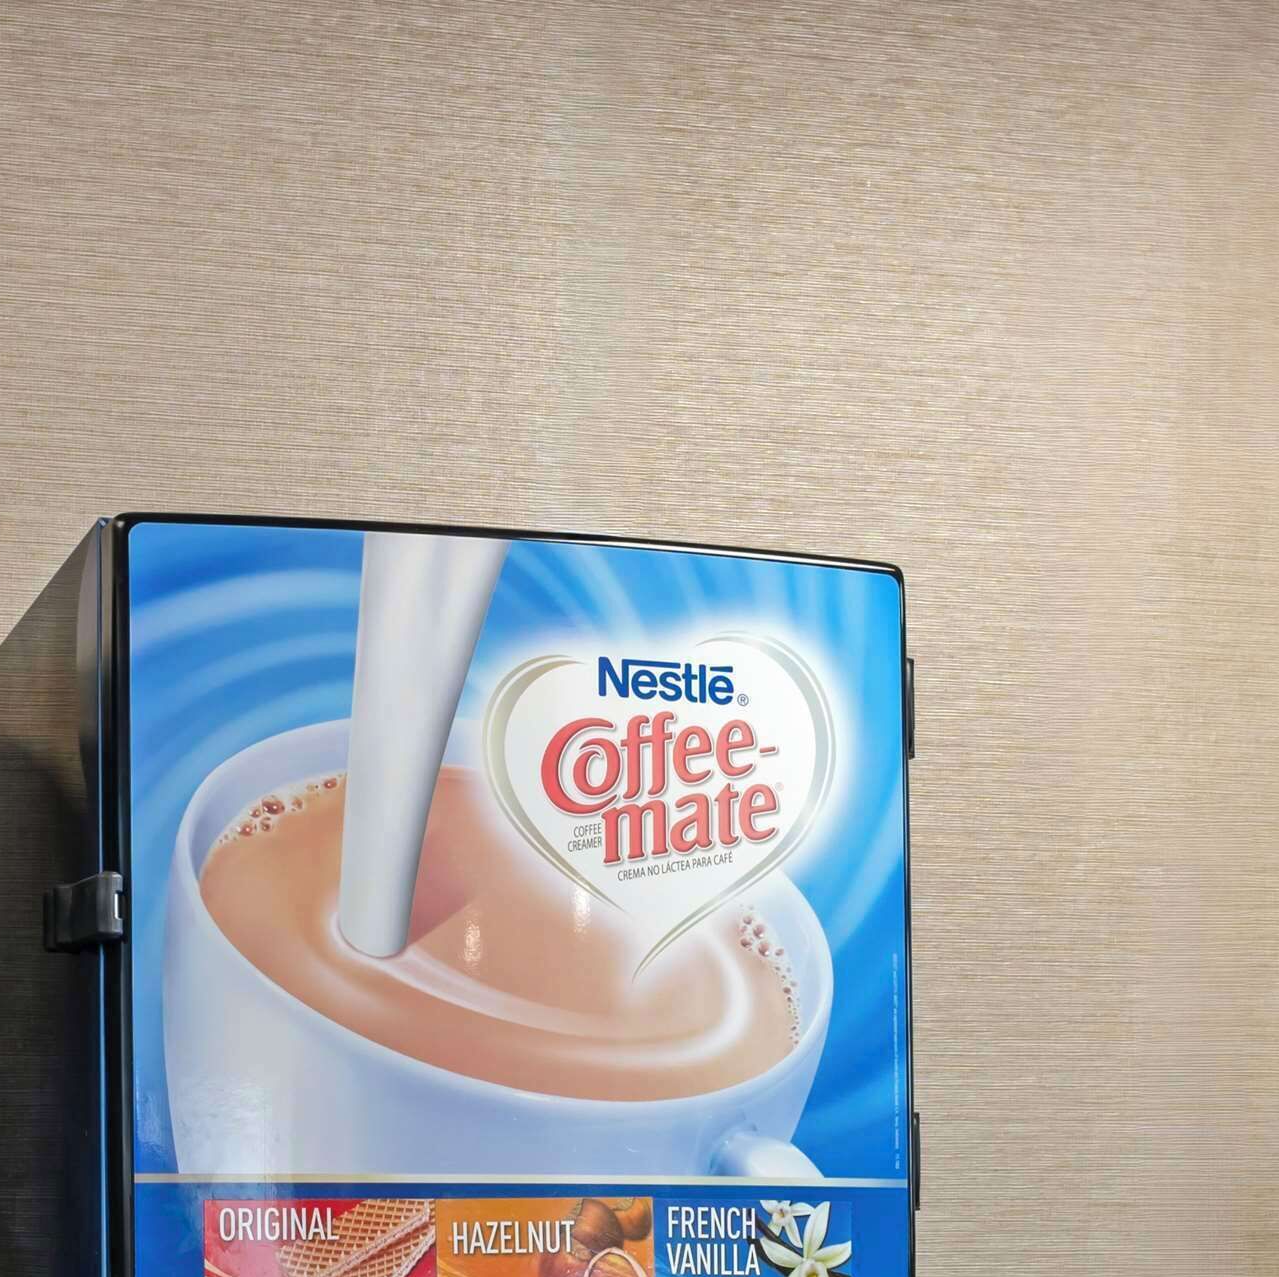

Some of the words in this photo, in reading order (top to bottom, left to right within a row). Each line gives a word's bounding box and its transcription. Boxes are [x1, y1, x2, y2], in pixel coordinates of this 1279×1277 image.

[598, 656, 734, 706] Nestlé
[540, 710, 777, 816] Coffee-
[573, 823, 602, 838] COFFEE
[602, 782, 777, 864] mate
[567, 836, 602, 852] CREAMER
[617, 869, 646, 882] CREMA
[647, 865, 660, 877] NO
[692, 856, 712, 868] PARA
[713, 851, 733, 865] CAFÉ
[218, 1208, 340, 1242] ORIGINAL
[452, 1219, 575, 1256] HAZELNUT
[666, 1206, 756, 1240] FRENCH
[666, 1242, 760, 1276] VANILLA
